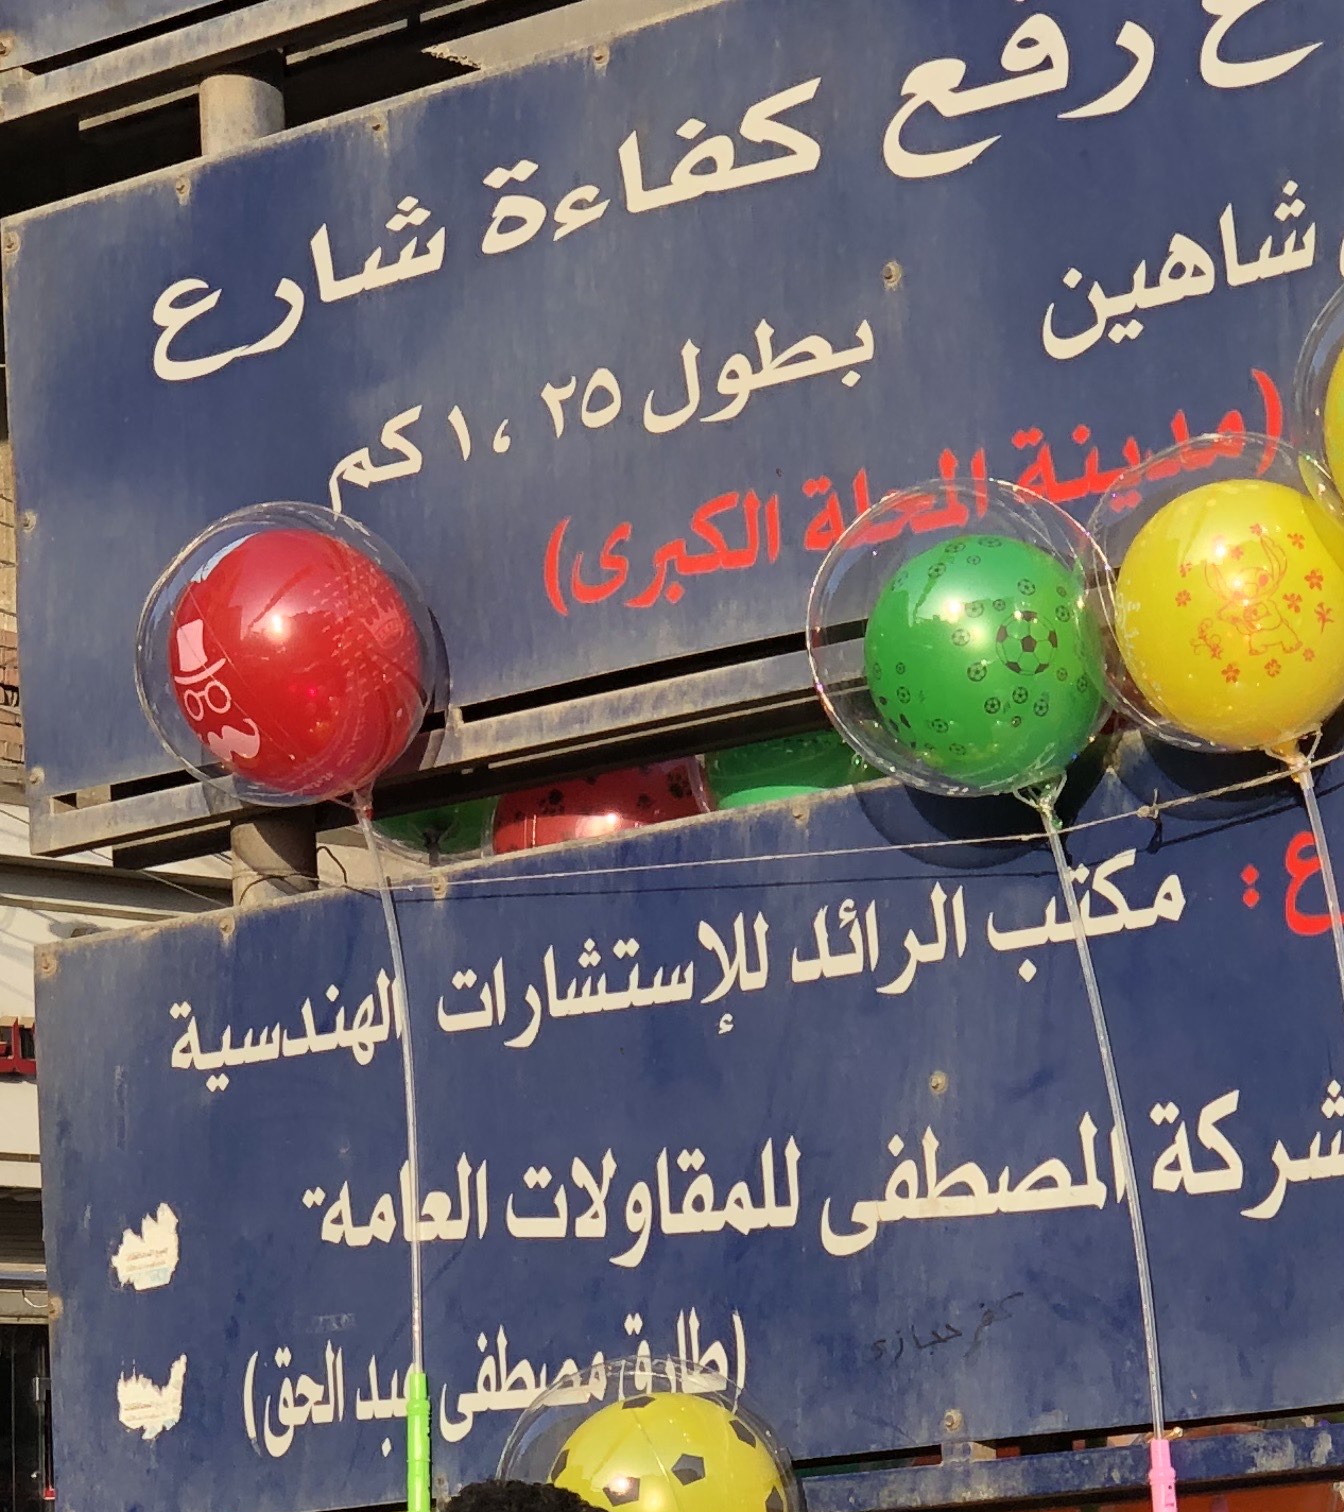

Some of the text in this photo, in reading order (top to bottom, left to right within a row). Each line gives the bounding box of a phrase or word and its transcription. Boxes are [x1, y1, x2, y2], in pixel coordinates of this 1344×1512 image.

[482, 77, 823, 256] كفاءة
[152, 197, 447, 381] شارع
[1041, 180, 1318, 360] شاهين
[643, 320, 875, 434] بطول
[328, 405, 424, 512] كم
[170, 849, 1187, 1093] مكتب الرائد للإستشارات الهندسية
[303, 1151, 489, 1249] العامة
[507, 1135, 801, 1269] للمقاولات
[820, 1110, 1131, 1257] المصطفى
[440, 1324, 607, 1443] مصطفى
